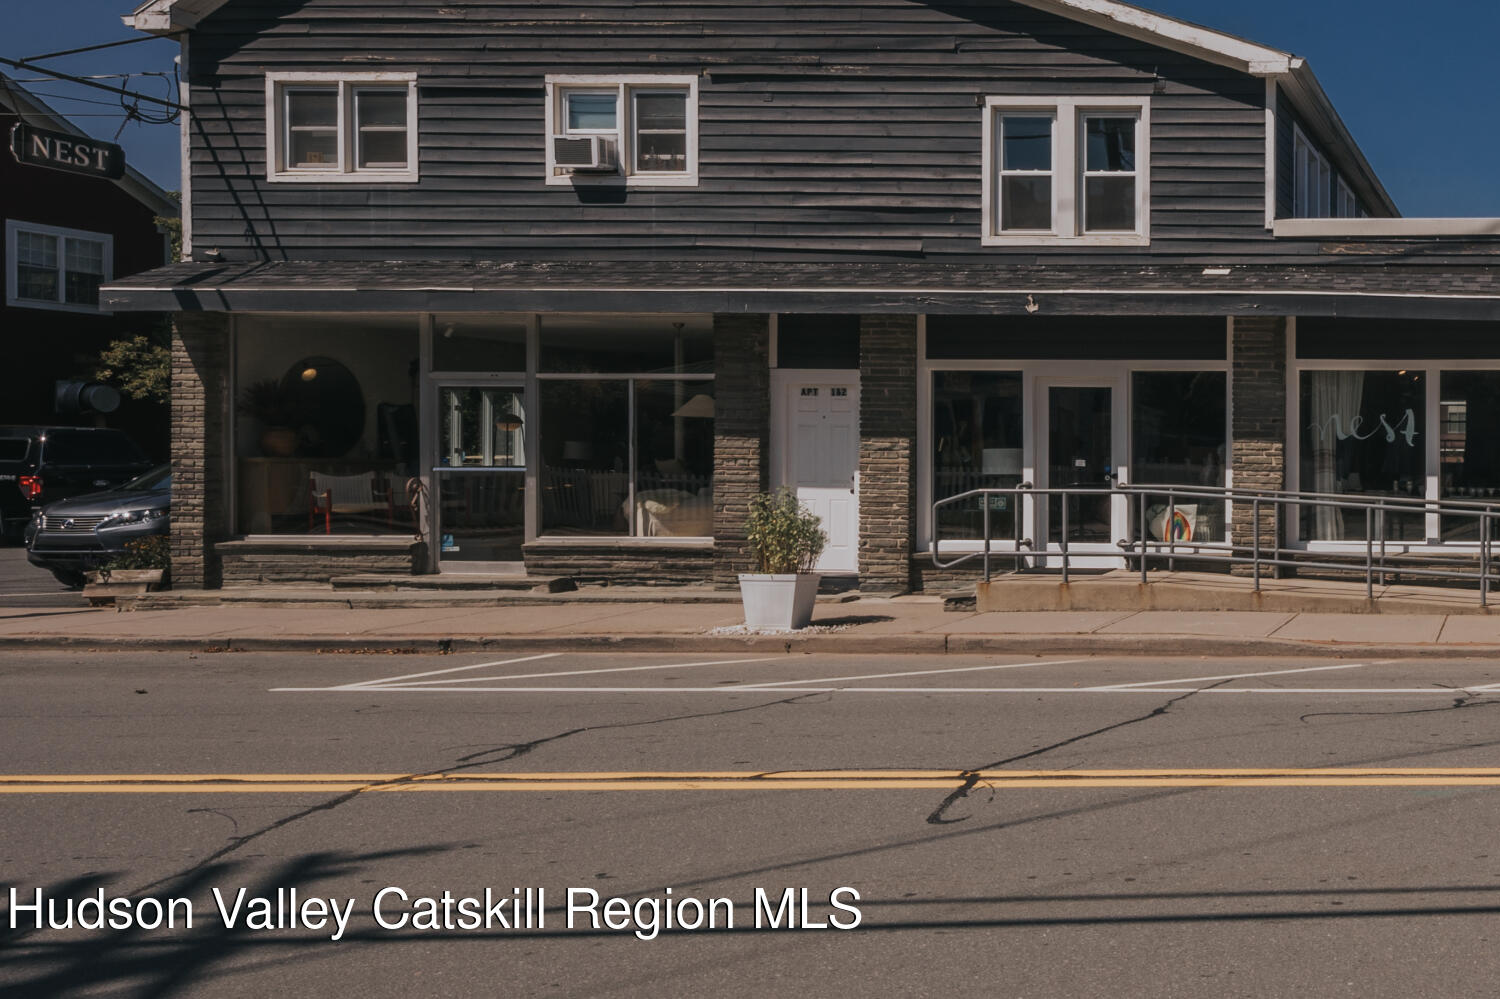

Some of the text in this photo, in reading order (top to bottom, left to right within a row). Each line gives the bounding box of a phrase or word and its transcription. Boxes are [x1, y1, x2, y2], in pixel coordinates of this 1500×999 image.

[31, 134, 109, 171] NEST
[801, 388, 819, 397] APT
[1306, 408, 1420, 447] nest
